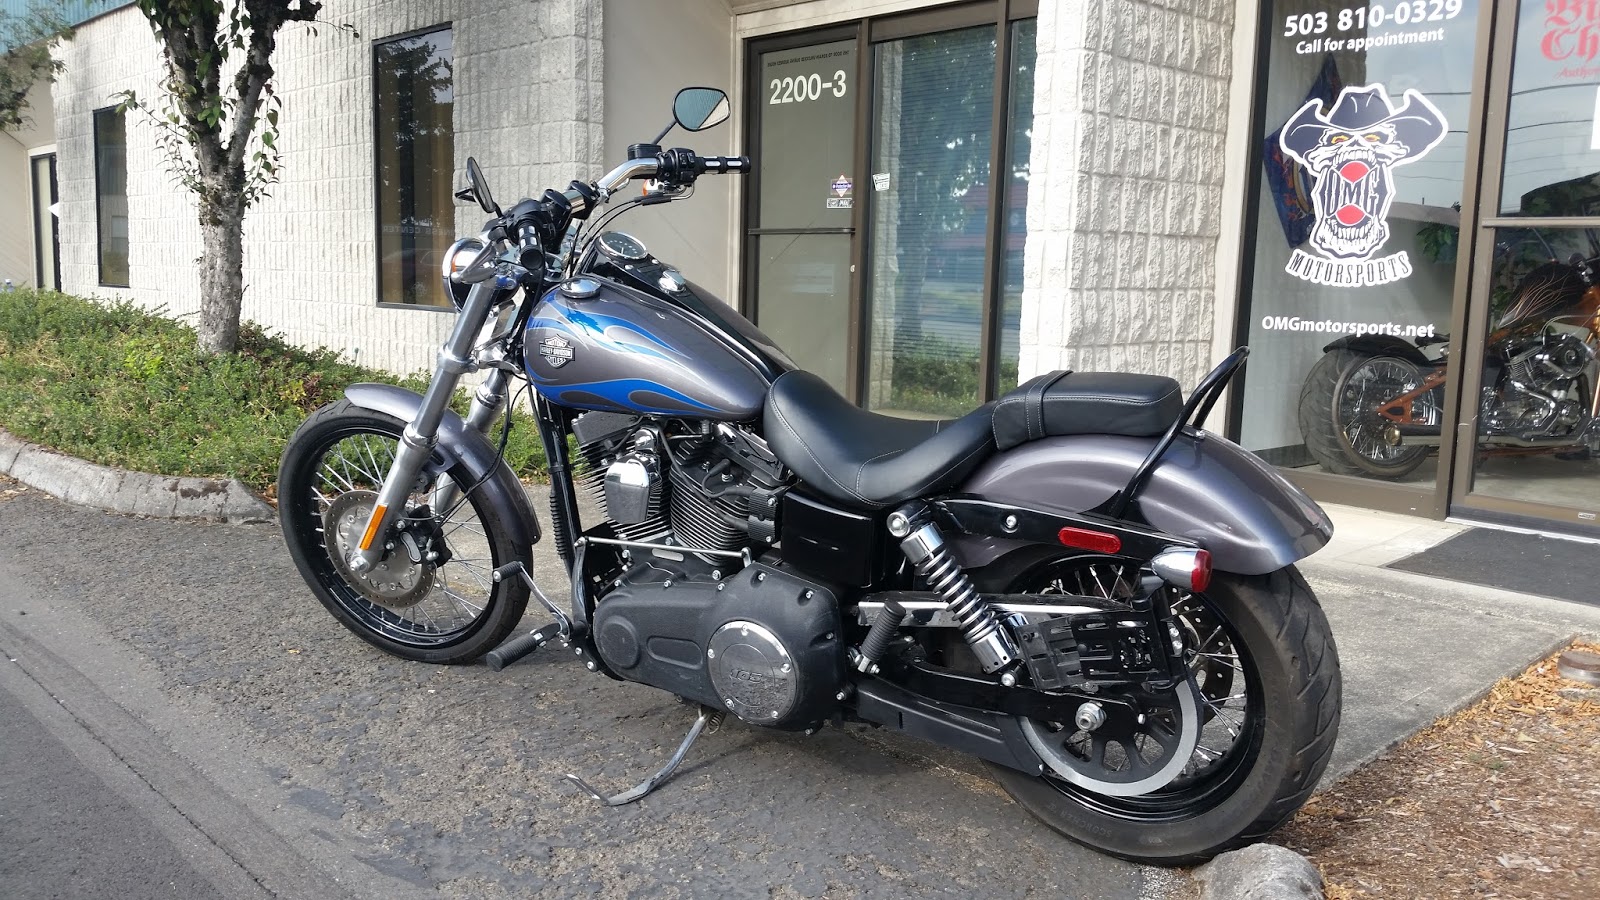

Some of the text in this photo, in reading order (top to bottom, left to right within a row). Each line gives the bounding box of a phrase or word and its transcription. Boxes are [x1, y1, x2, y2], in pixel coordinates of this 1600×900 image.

[1283, 0, 1463, 37] 503 810-0329
[1296, 28, 1444, 54] Call for appointment
[769, 69, 847, 105] 2200-3
[1324, 165, 1381, 218] OMG
[1287, 251, 1411, 285] MOTORSPORTS
[1261, 315, 1435, 338] OMGmotorsports.net
